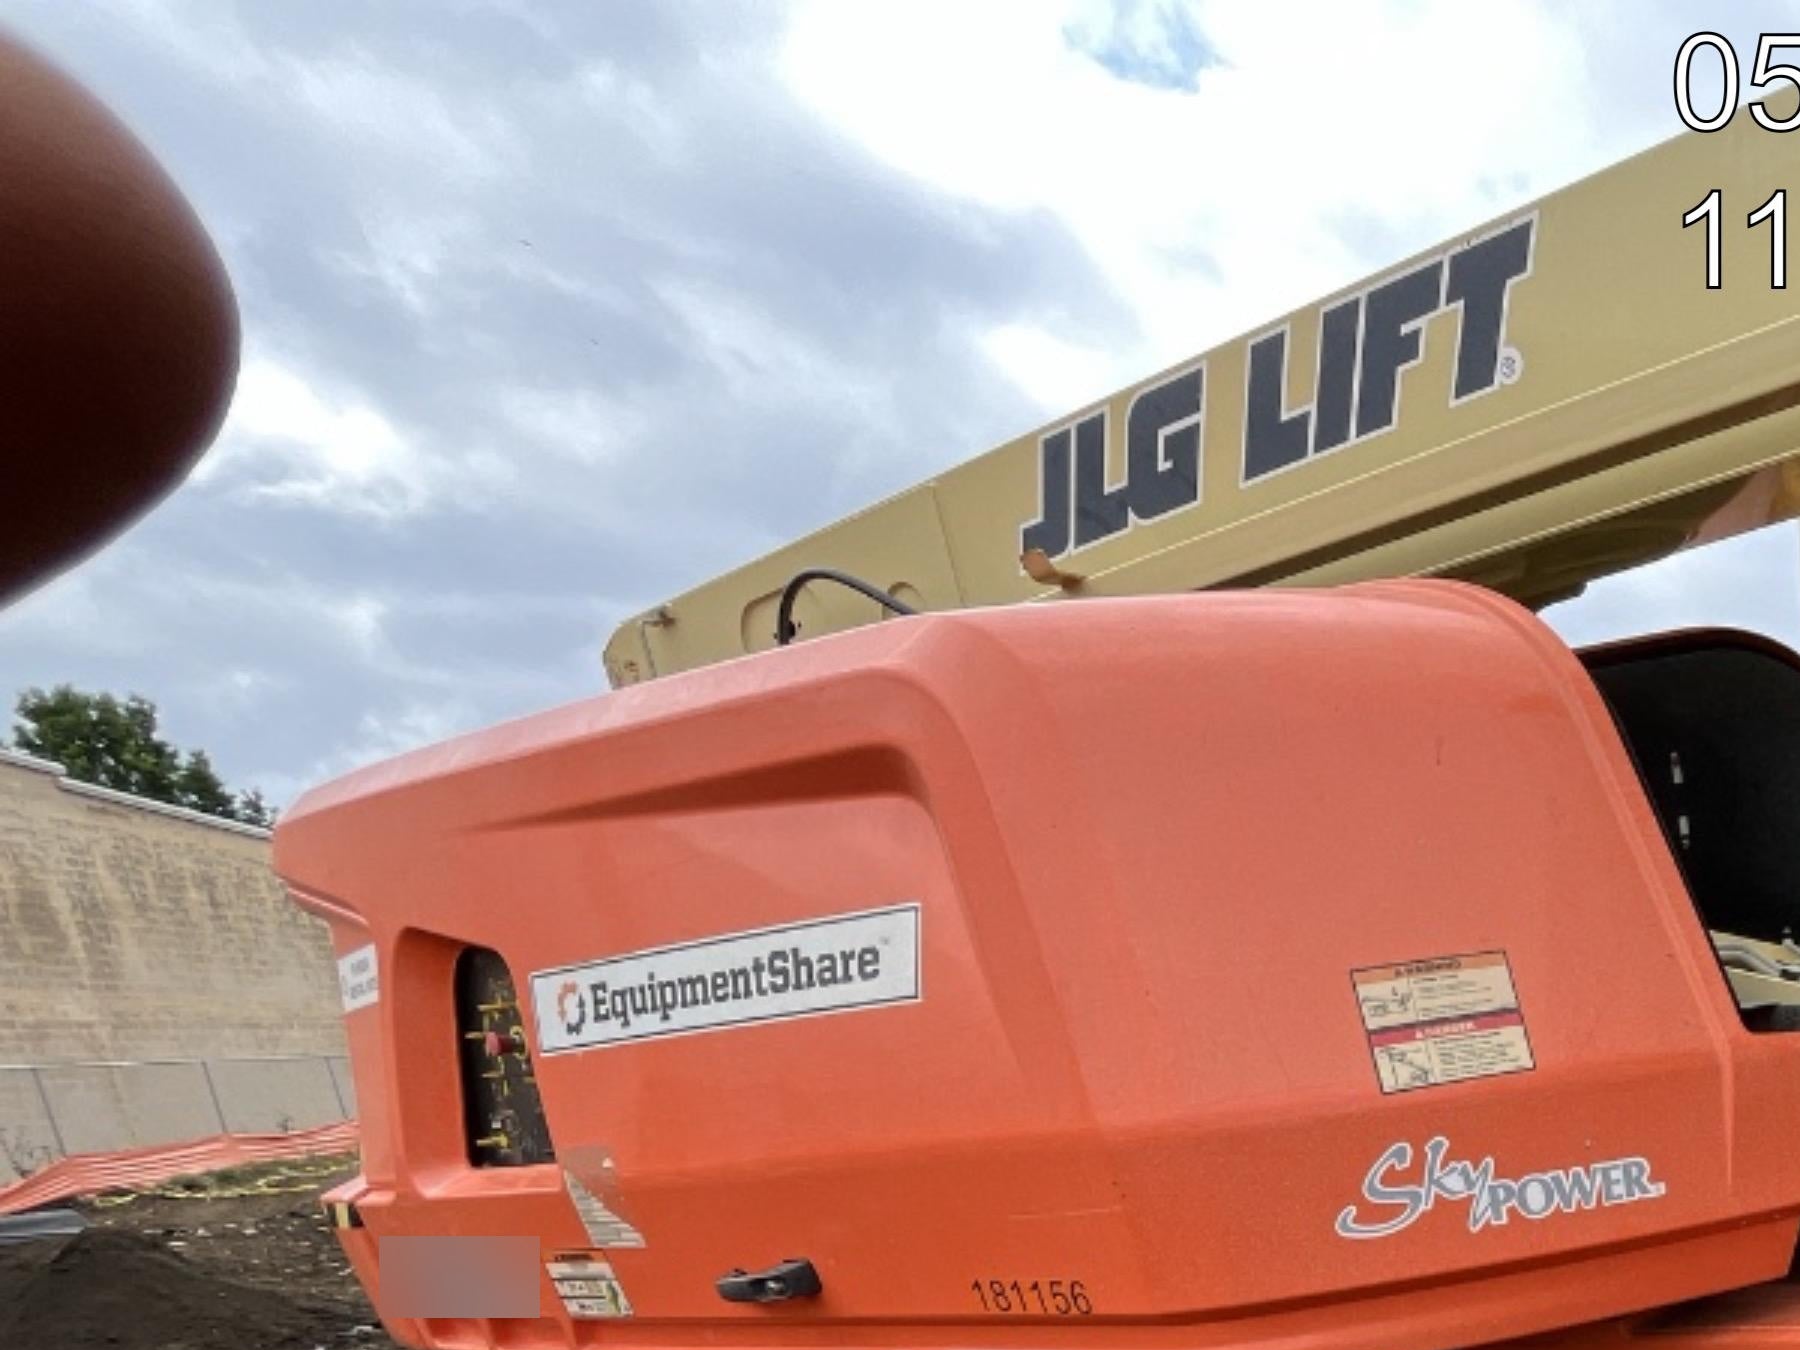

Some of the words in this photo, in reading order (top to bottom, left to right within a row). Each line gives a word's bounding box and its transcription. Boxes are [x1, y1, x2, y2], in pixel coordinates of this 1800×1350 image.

[1020, 360, 1206, 563] JLG
[1240, 210, 1538, 488] LIFT
[589, 946, 881, 1026] EquipmentShare
[971, 1279, 1093, 1315] 181156
